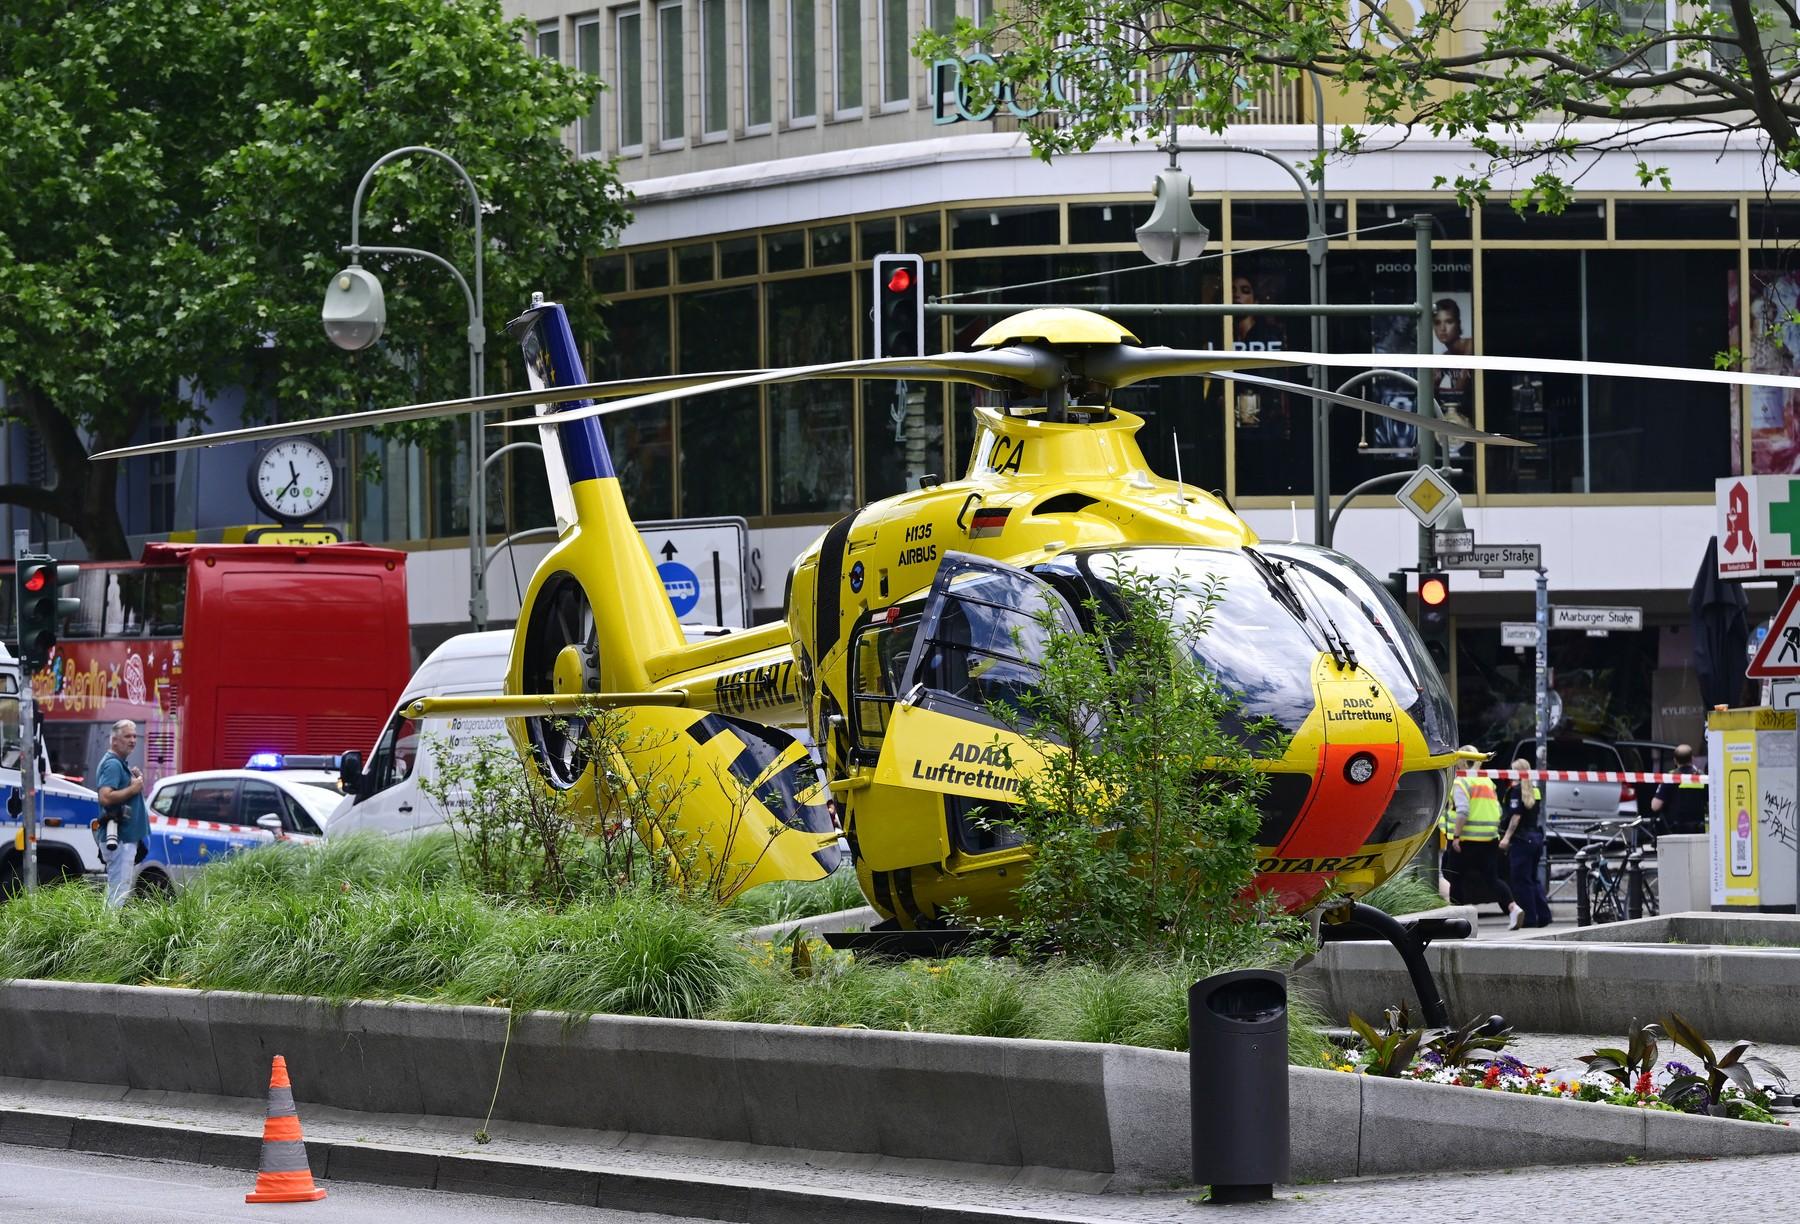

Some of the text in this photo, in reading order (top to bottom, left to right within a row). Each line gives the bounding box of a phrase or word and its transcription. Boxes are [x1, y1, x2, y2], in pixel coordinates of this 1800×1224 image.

[1376, 263, 1411, 274] paco
[905, 523, 933, 542] H135
[898, 545, 937, 567] AIRBUS
[1458, 549, 1534, 565] arburger Straße
[1559, 611, 1634, 624] Marburger Straße
[65, 658, 107, 712] Berlin
[716, 660, 801, 715] NOTARZ
[1343, 698, 1374, 708] ADAC
[1327, 709, 1393, 723] Luftrettung
[948, 742, 1011, 768] ADAC
[912, 759, 1019, 793] Luftrettun
[1255, 853, 1383, 873] OTARZT
